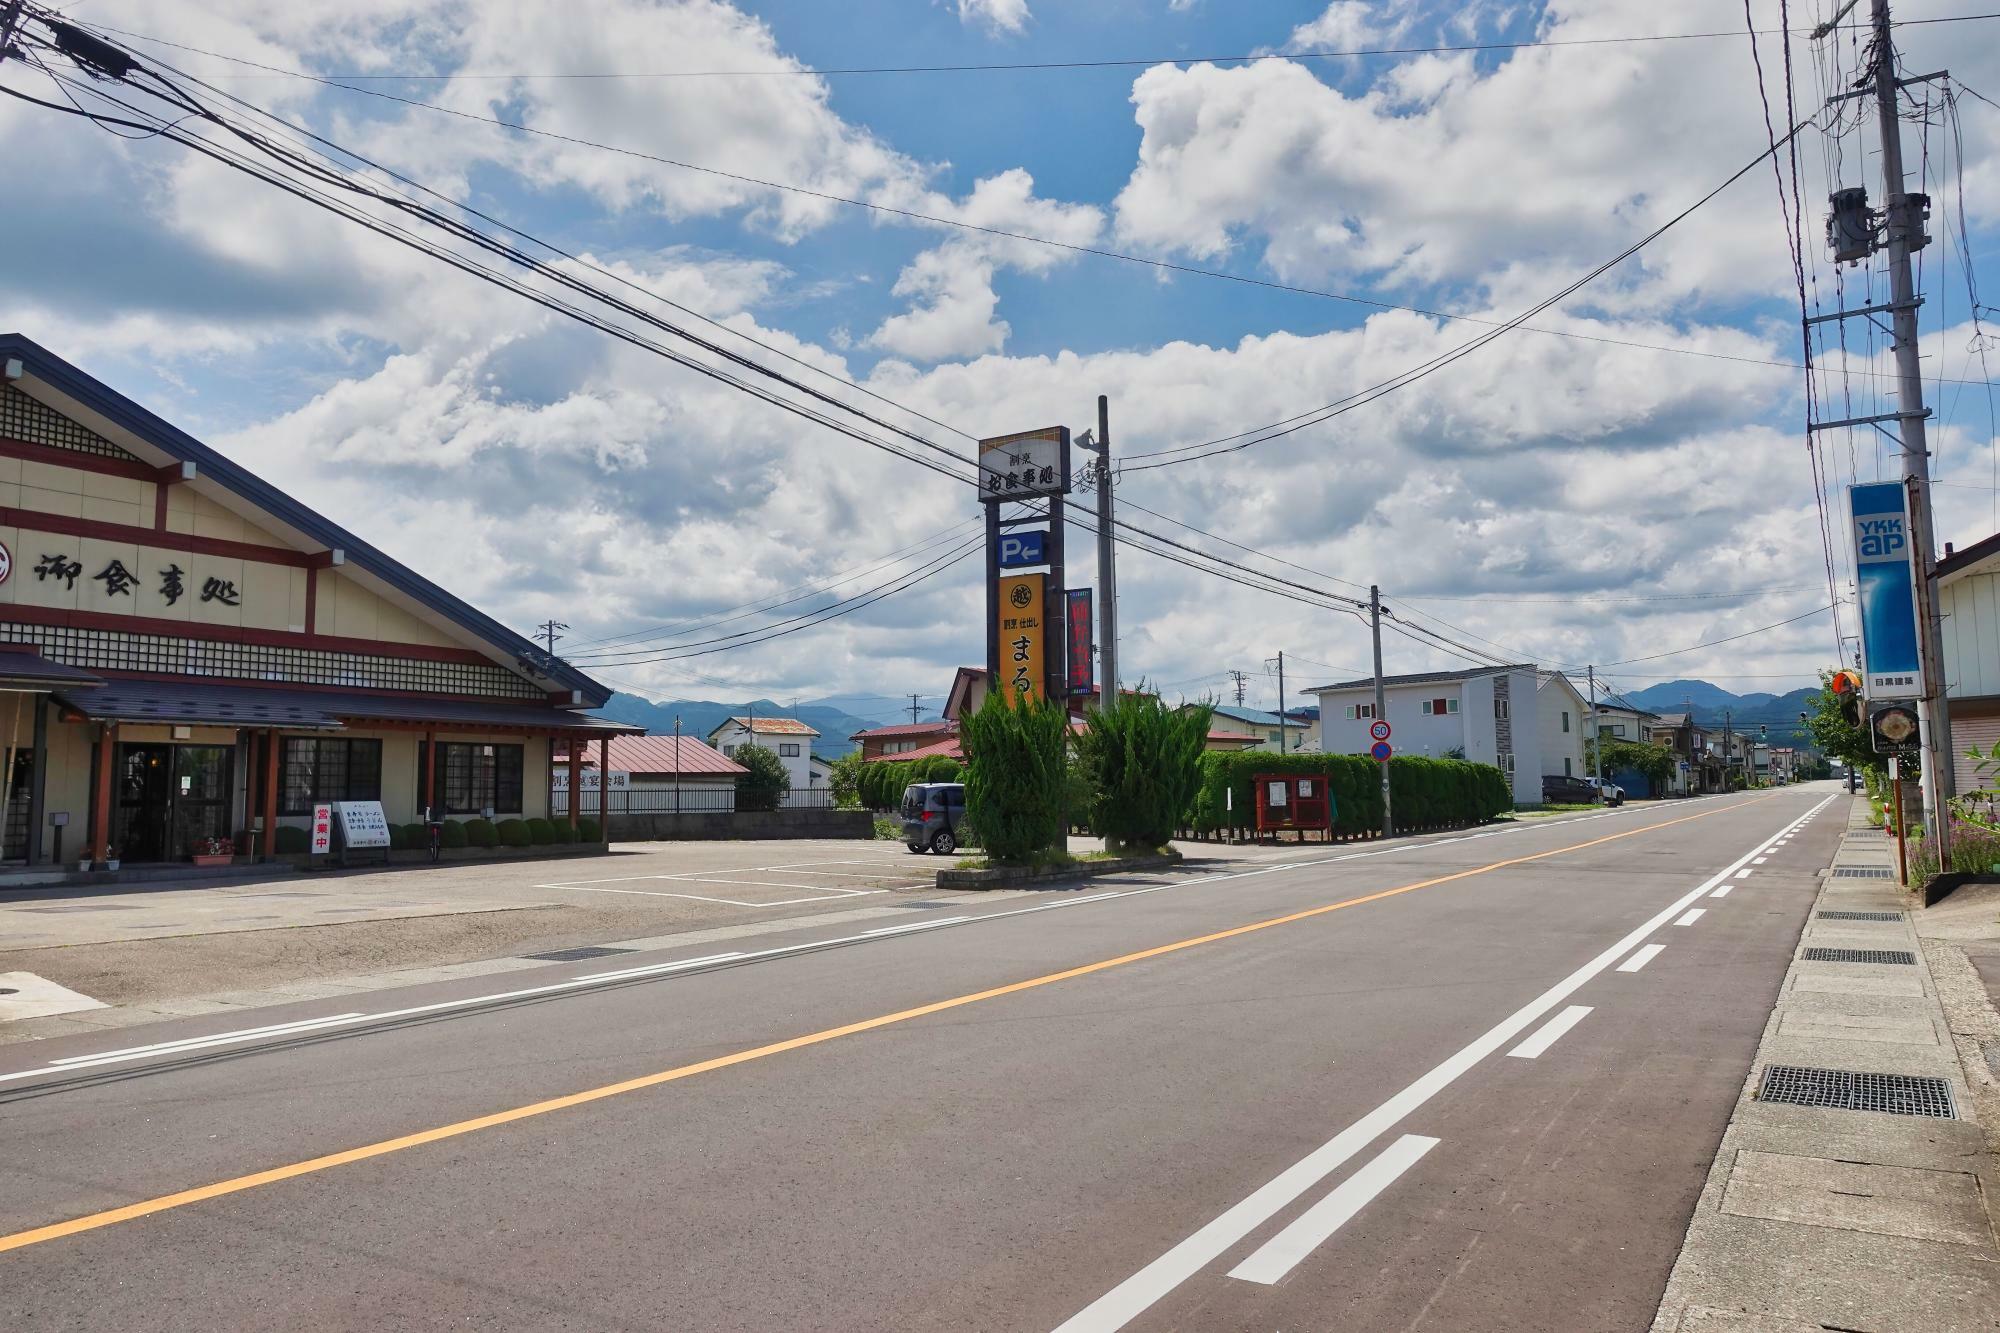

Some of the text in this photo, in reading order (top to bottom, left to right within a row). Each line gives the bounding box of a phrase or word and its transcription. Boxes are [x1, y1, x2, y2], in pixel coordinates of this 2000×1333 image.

[1858, 519, 1902, 535] YKK
[1002, 539, 1021, 563] P
[1861, 534, 1904, 556] ap
[34, 554, 240, 606] 御食事処
[1020, 616, 1039, 629] 仕出し
[1374, 726, 1387, 736] 50
[316, 808, 329, 848] 営業中
